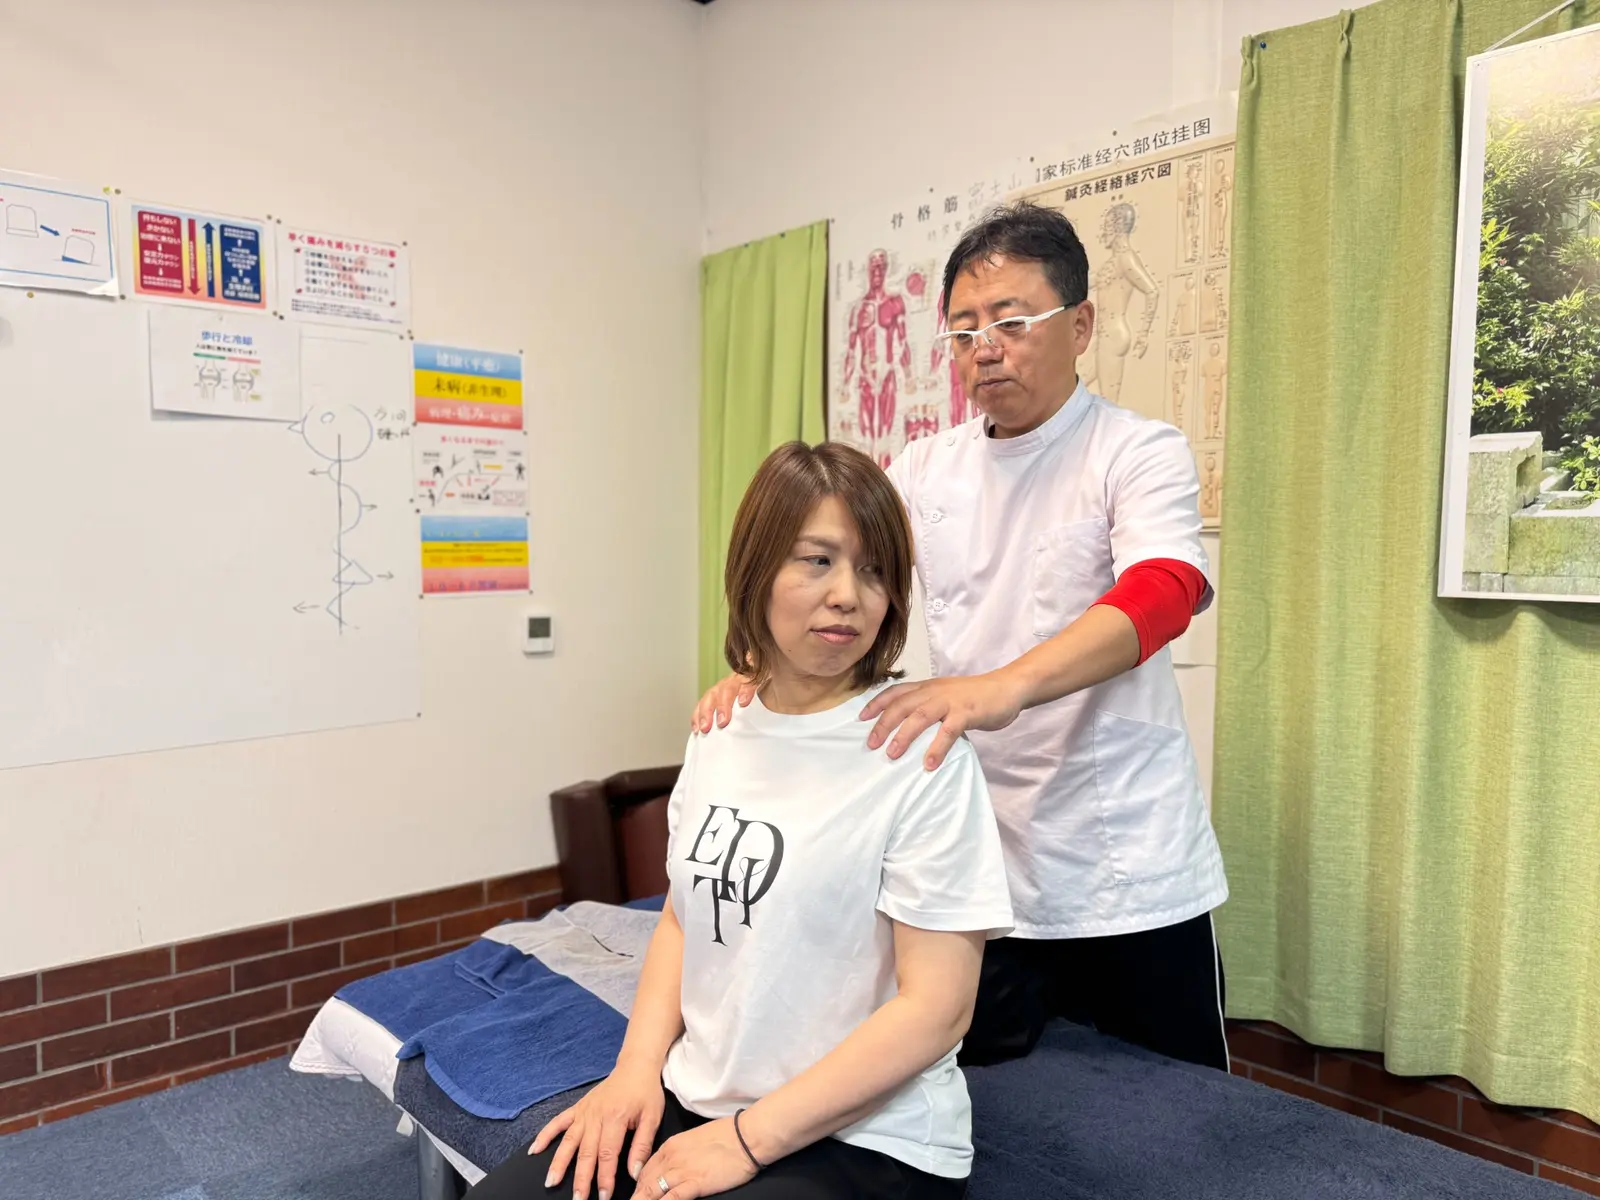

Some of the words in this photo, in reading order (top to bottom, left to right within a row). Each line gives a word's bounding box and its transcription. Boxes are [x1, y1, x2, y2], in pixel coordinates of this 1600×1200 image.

[1036, 117, 1211, 183] 家标准经穴部位挂图
[1064, 162, 1172, 202] 鍼灸経絡経穴図
